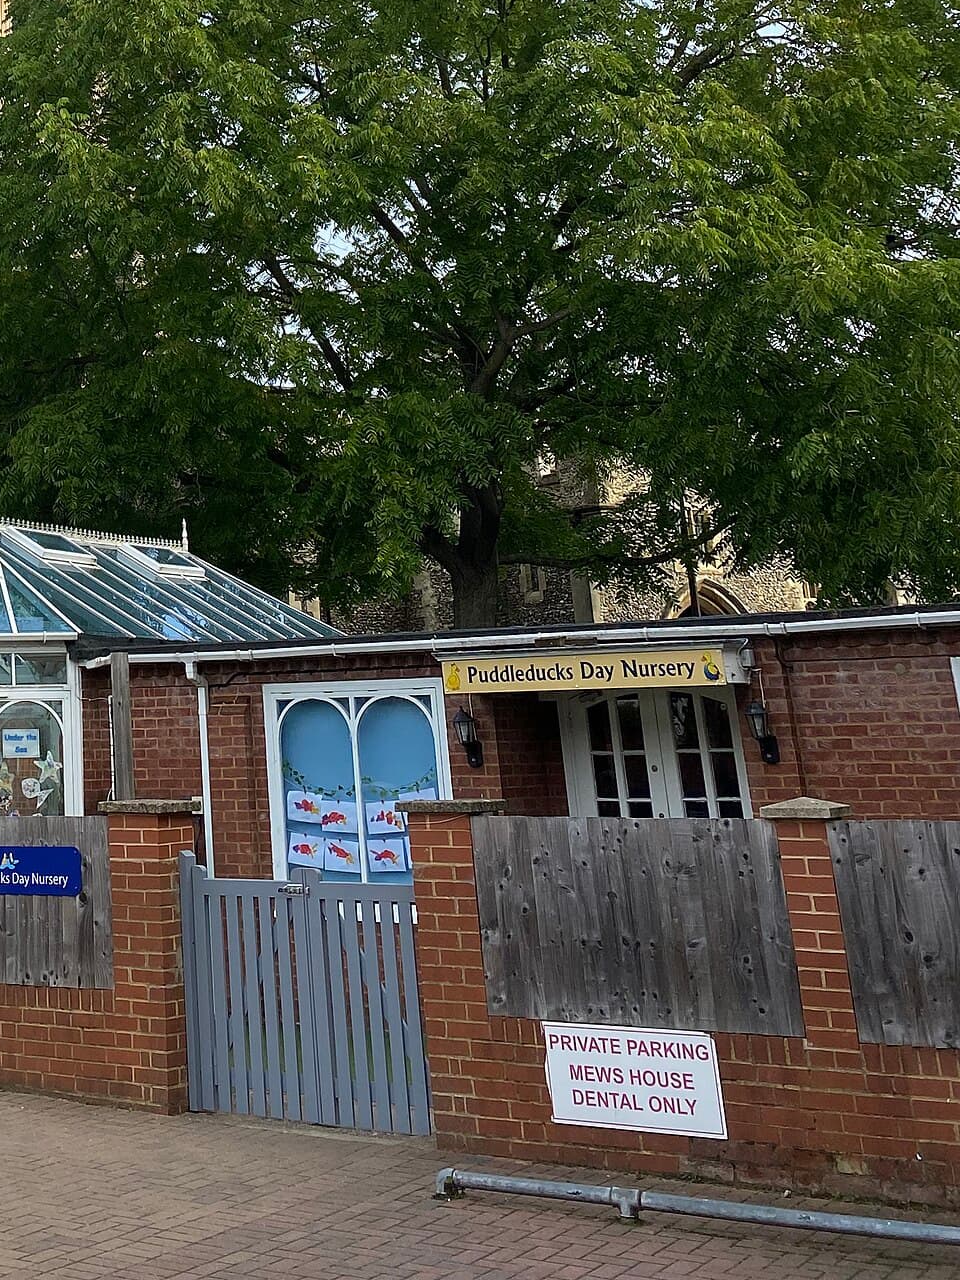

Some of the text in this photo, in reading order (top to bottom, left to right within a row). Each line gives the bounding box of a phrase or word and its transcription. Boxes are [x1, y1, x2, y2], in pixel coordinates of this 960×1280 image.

[468, 660, 696, 684] Puddleducks Day Nursery
[12, 872, 30, 888] Day
[31, 872, 69, 889] Nursery
[549, 1034, 709, 1061] PRIVATE PARKING
[569, 1064, 695, 1090] MEWS HOUSE
[572, 1089, 697, 1116] DENTAL ONLY
